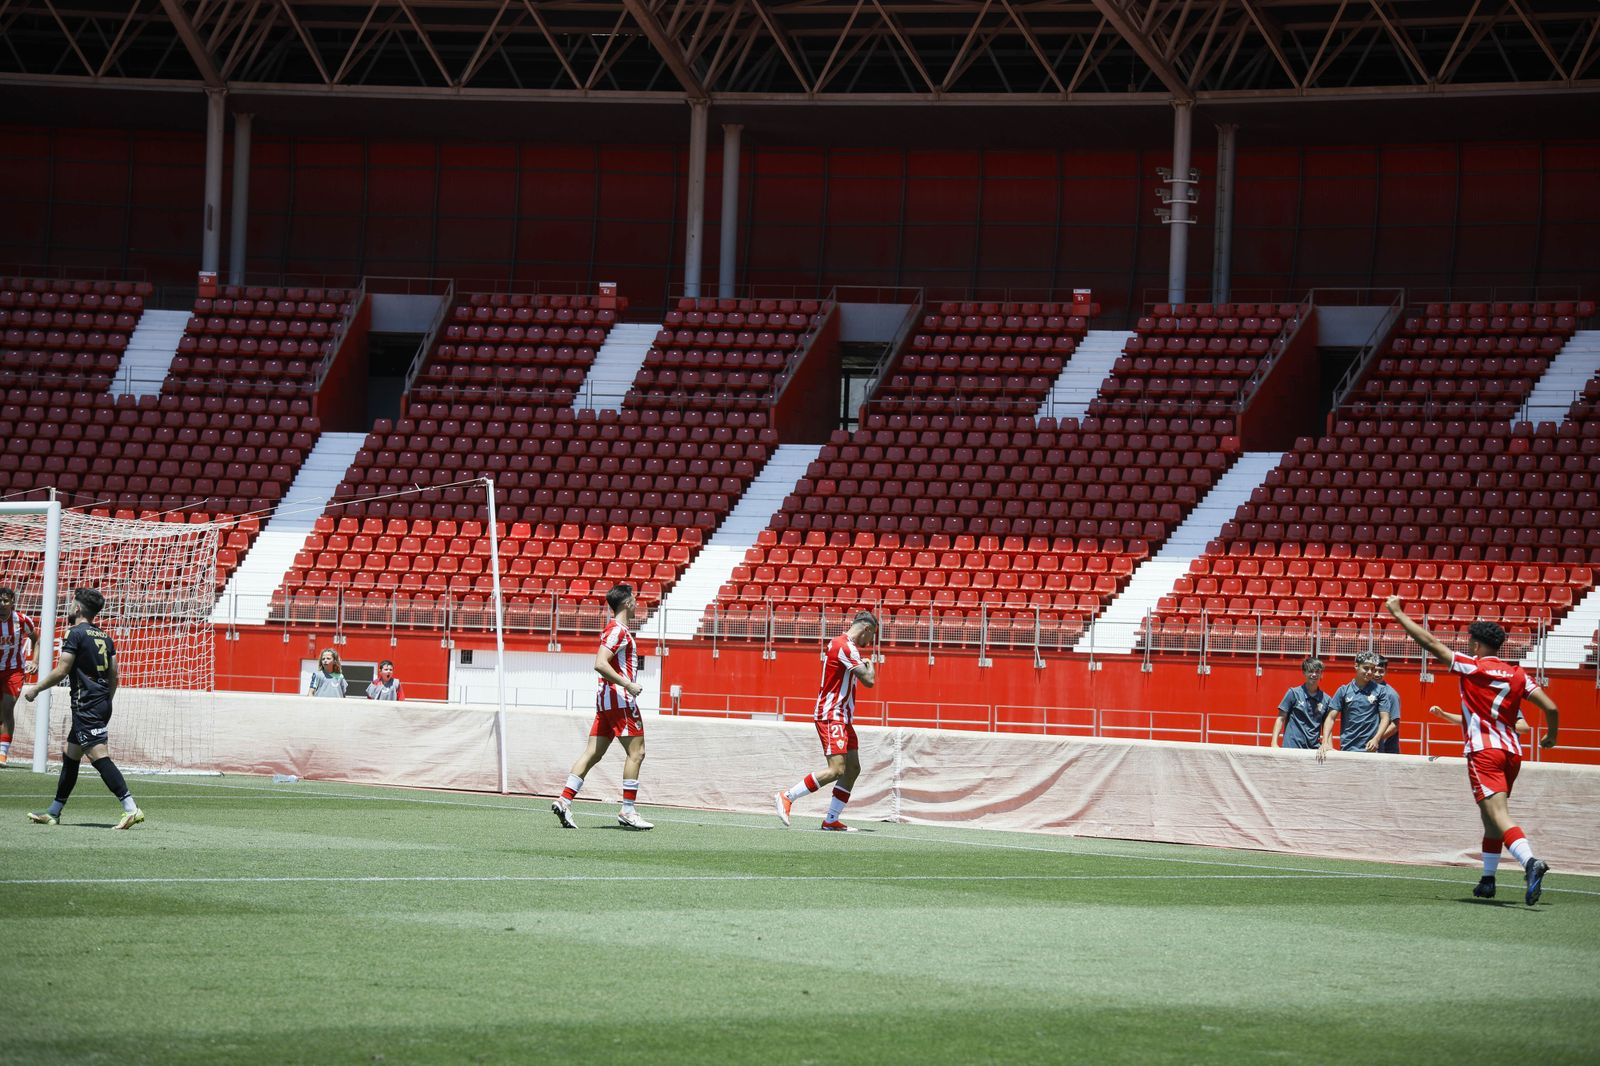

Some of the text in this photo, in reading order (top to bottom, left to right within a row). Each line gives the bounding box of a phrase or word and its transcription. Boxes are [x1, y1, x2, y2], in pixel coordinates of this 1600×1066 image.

[93, 638, 109, 672] 3
[1489, 680, 1511, 720] 7
[831, 724, 845, 738] 21
